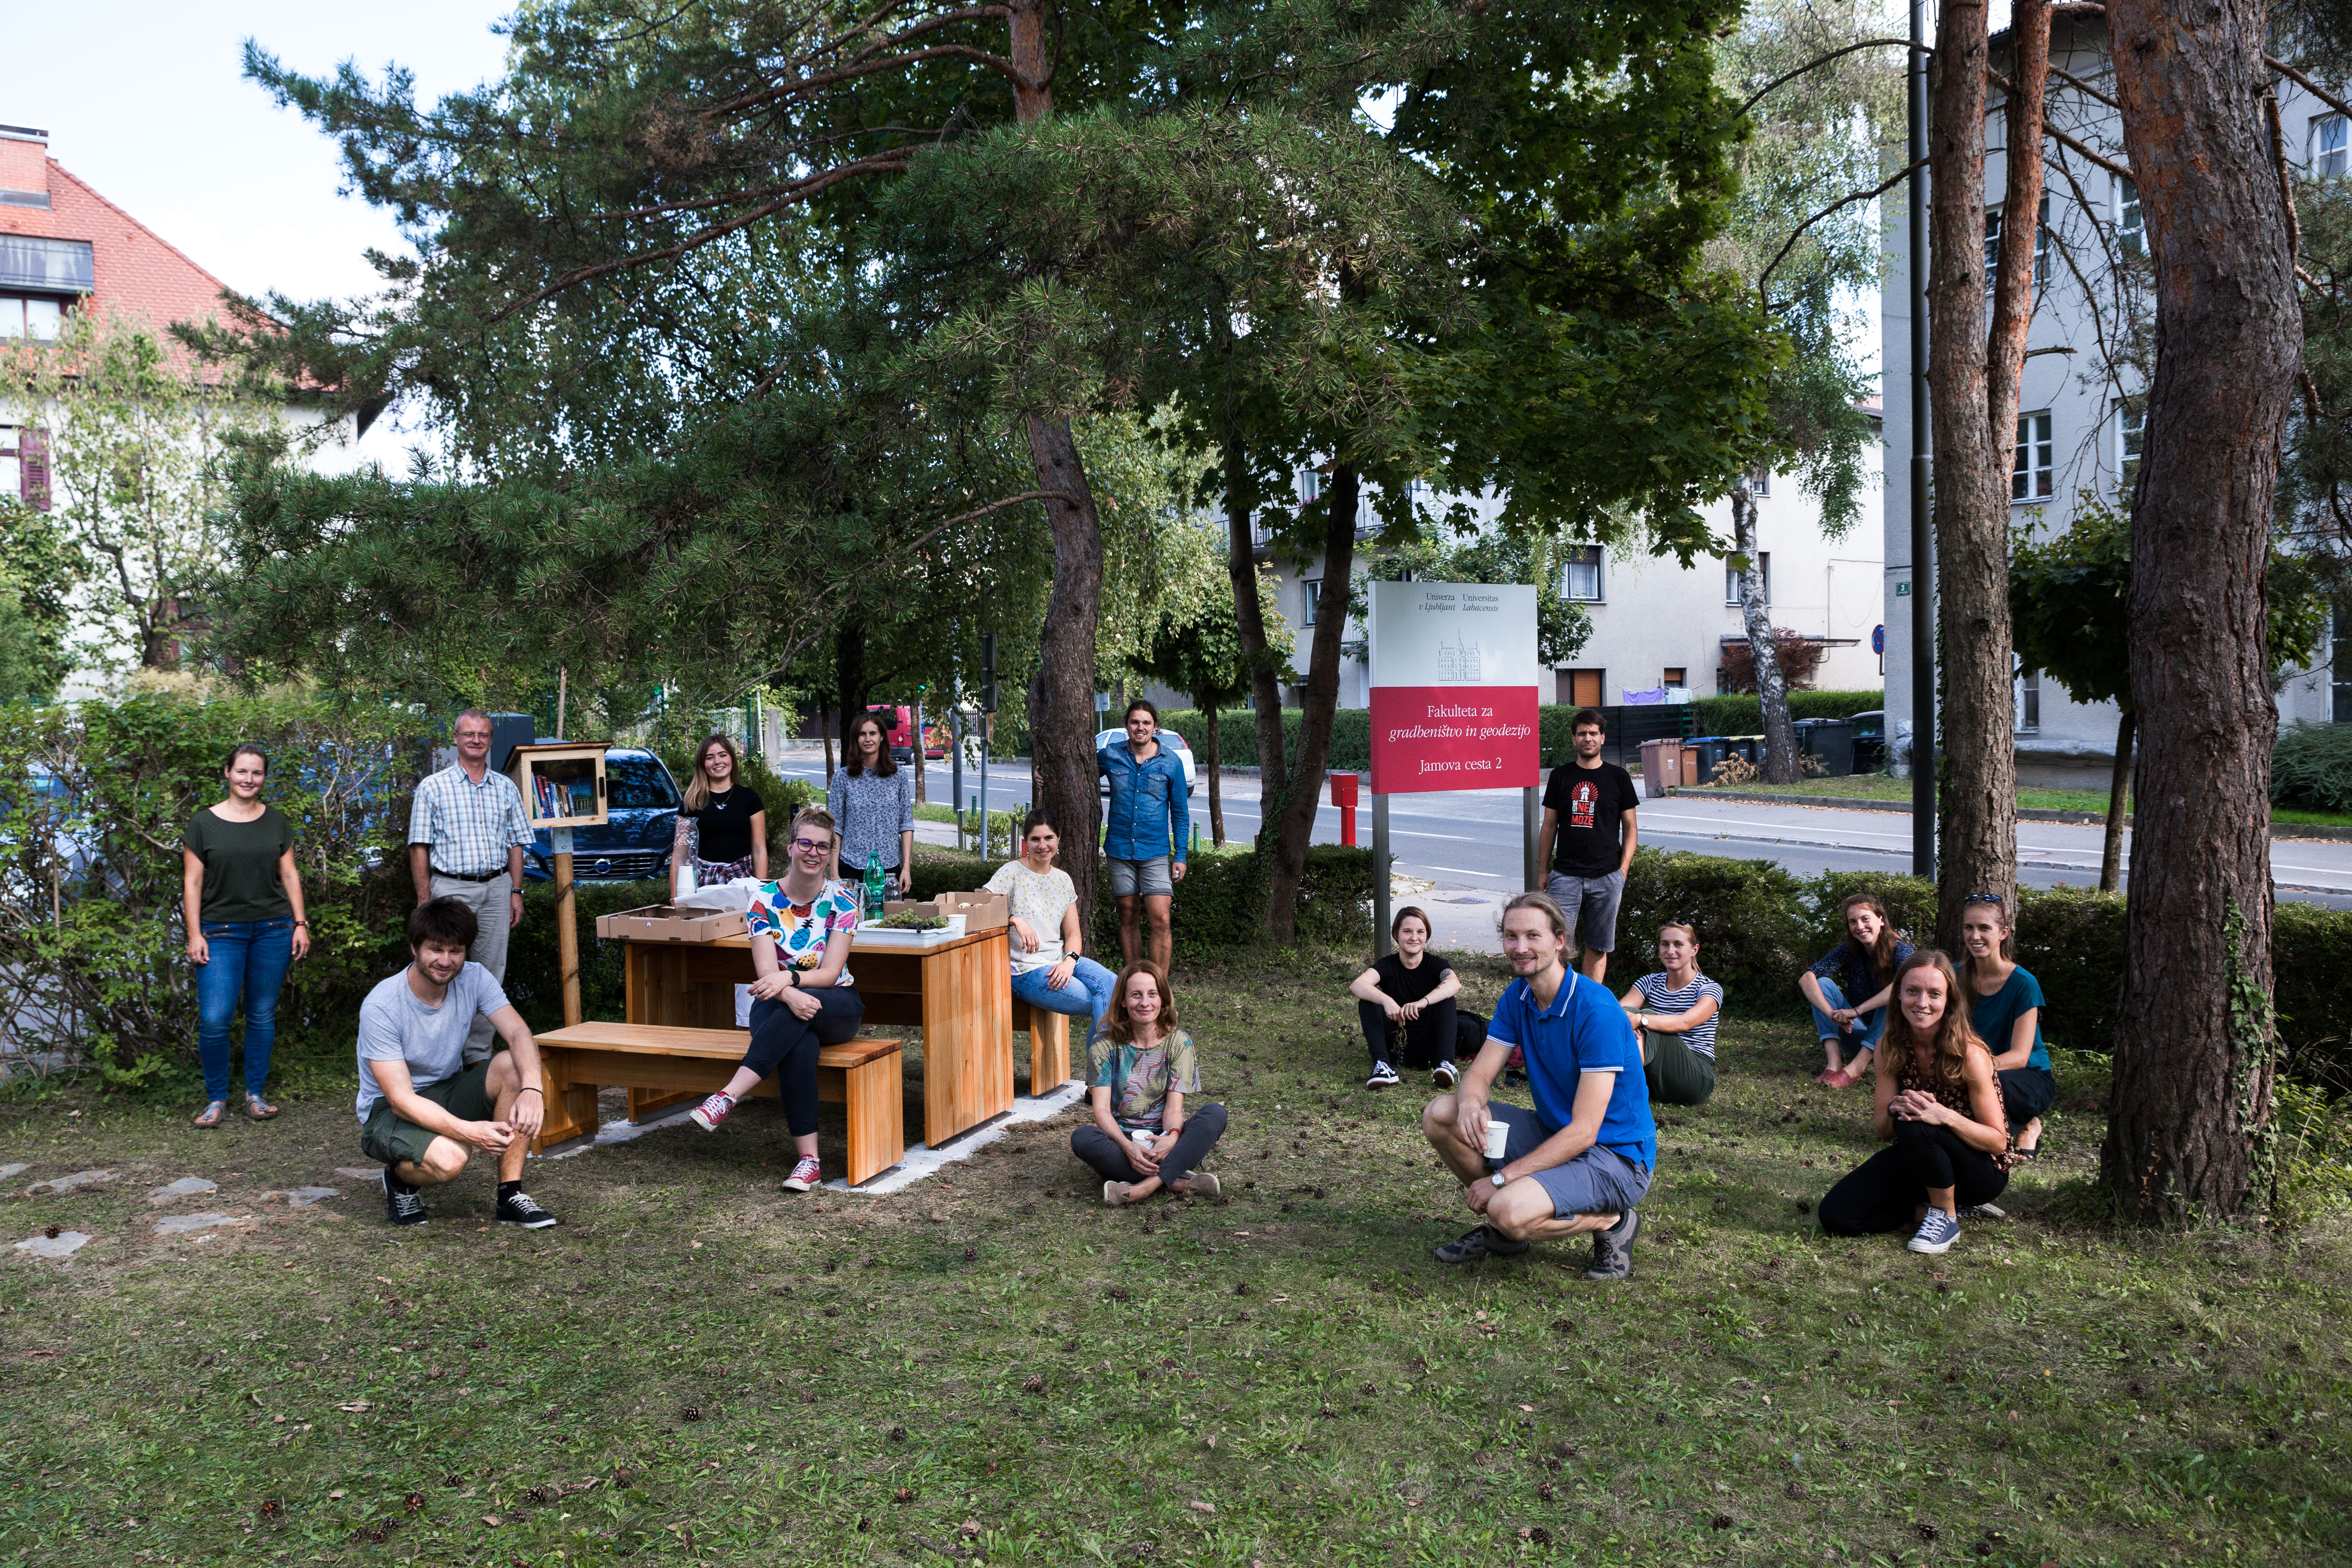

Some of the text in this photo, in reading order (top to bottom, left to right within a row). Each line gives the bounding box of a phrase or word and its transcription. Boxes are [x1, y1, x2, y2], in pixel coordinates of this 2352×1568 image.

[1426, 593, 1455, 601] Univerza
[1463, 594, 1498, 602] Universitas
[1425, 603, 1456, 613] Ljubljani
[1427, 705, 1493, 718] Fakulteta za
[1389, 723, 1531, 742] gradbeništvo in geodezijo
[1419, 757, 1502, 775] Jamova cesta 2
[1578, 802, 1589, 812] NE
[1571, 813, 1594, 826] MOŽE
